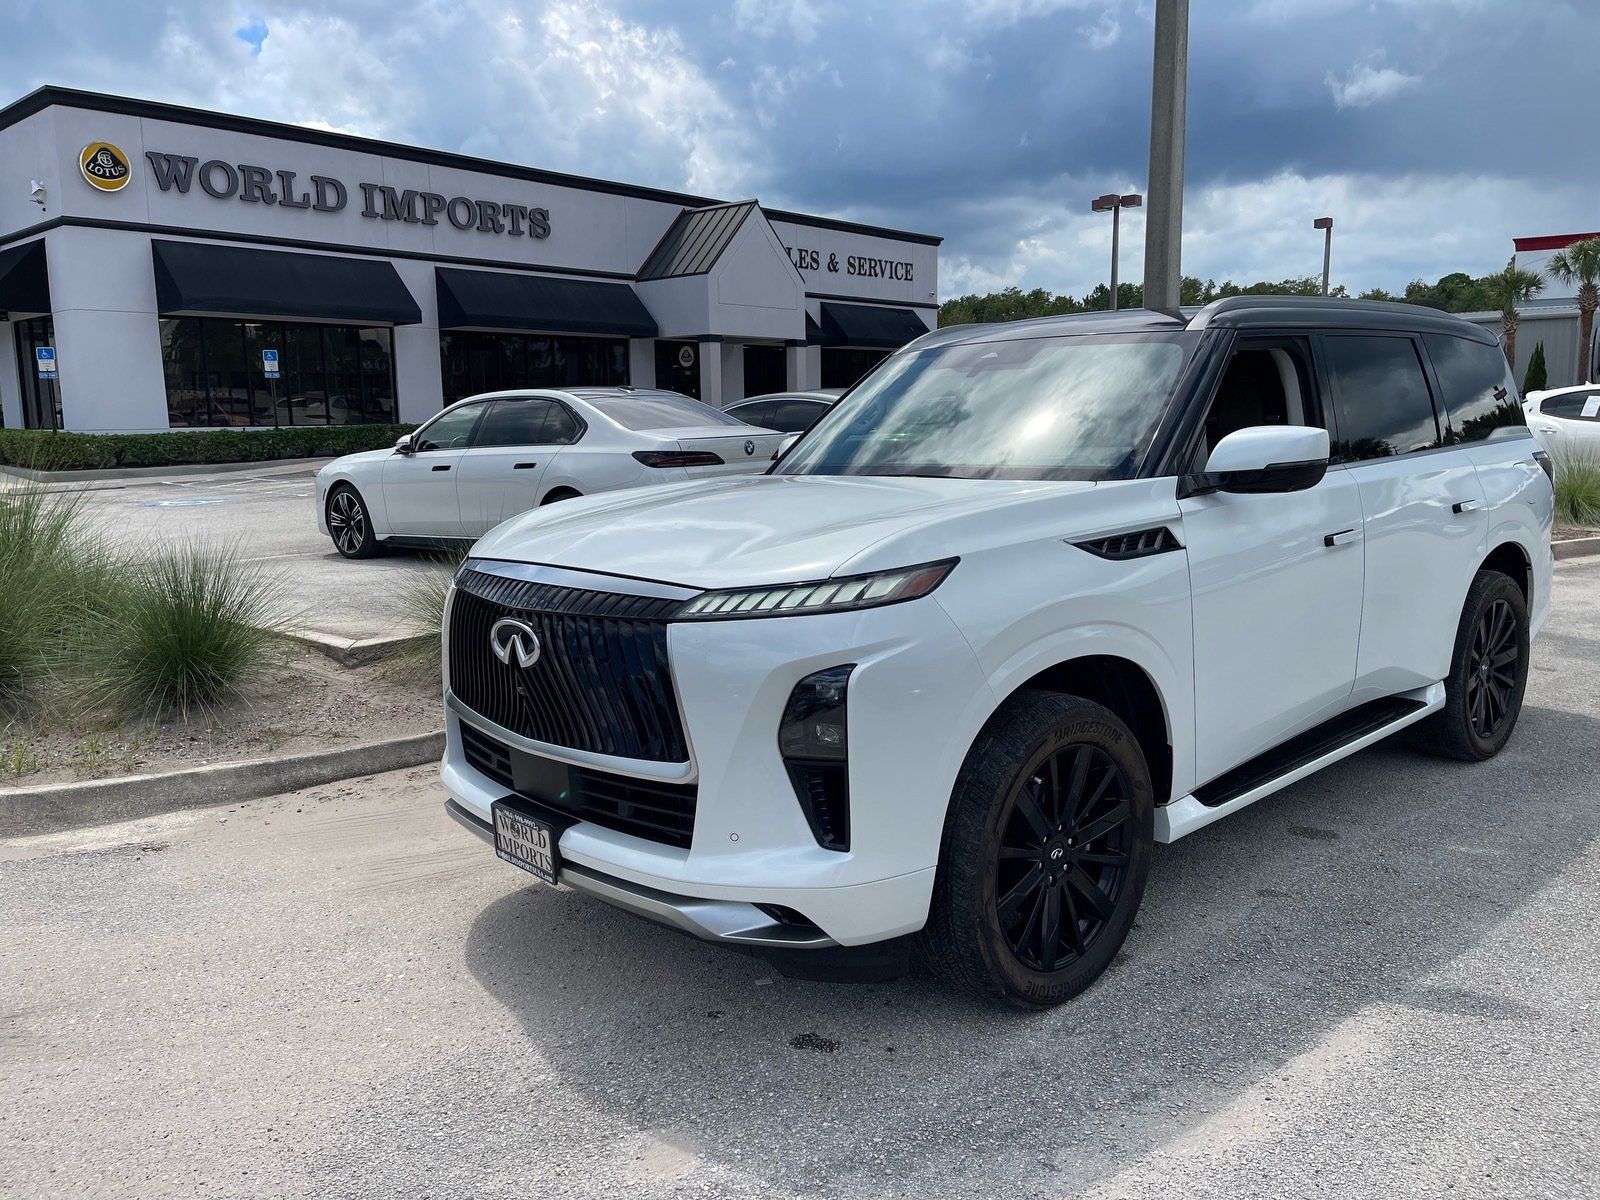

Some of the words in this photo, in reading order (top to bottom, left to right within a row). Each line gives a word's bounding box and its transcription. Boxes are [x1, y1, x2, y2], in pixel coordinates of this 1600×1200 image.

[88, 163, 125, 177] LOTUS
[146, 151, 348, 212] WORLD
[360, 183, 551, 239] IMPORTS
[827, 252, 839, 273] &
[847, 255, 913, 281] SERVICE
[1054, 720, 1124, 746] BRIDGESTONE
[499, 814, 547, 849] WORLD
[497, 832, 552, 872] IMPORTS
